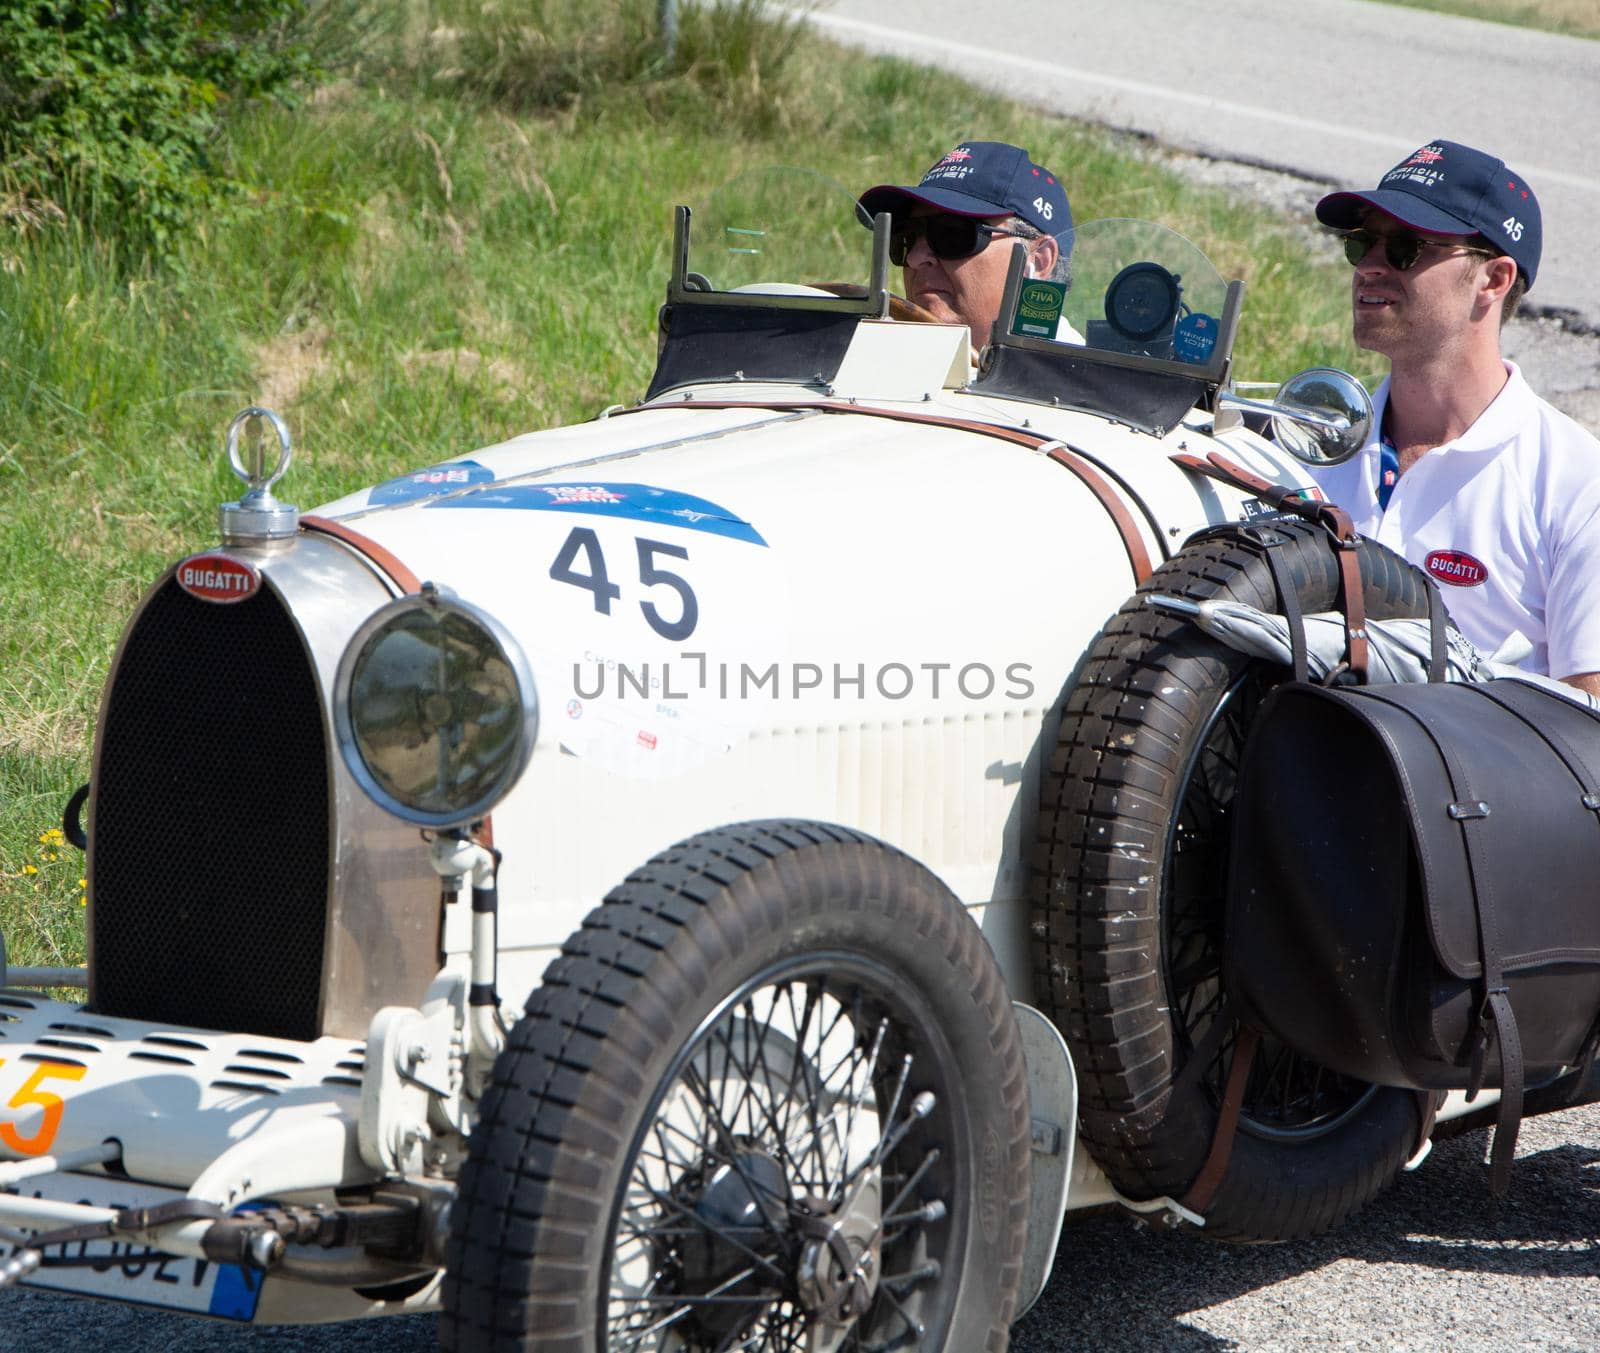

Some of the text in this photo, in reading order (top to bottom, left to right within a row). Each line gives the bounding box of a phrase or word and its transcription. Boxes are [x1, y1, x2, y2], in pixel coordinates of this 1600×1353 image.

[1032, 197, 1053, 220] 45
[1503, 217, 1524, 241] 45
[1030, 291, 1054, 303] FIVA
[1020, 304, 1059, 320] REGISTERED
[1430, 557, 1480, 580] BUGATTI
[184, 569, 250, 592] BUGATTI
[549, 526, 698, 642] 45
